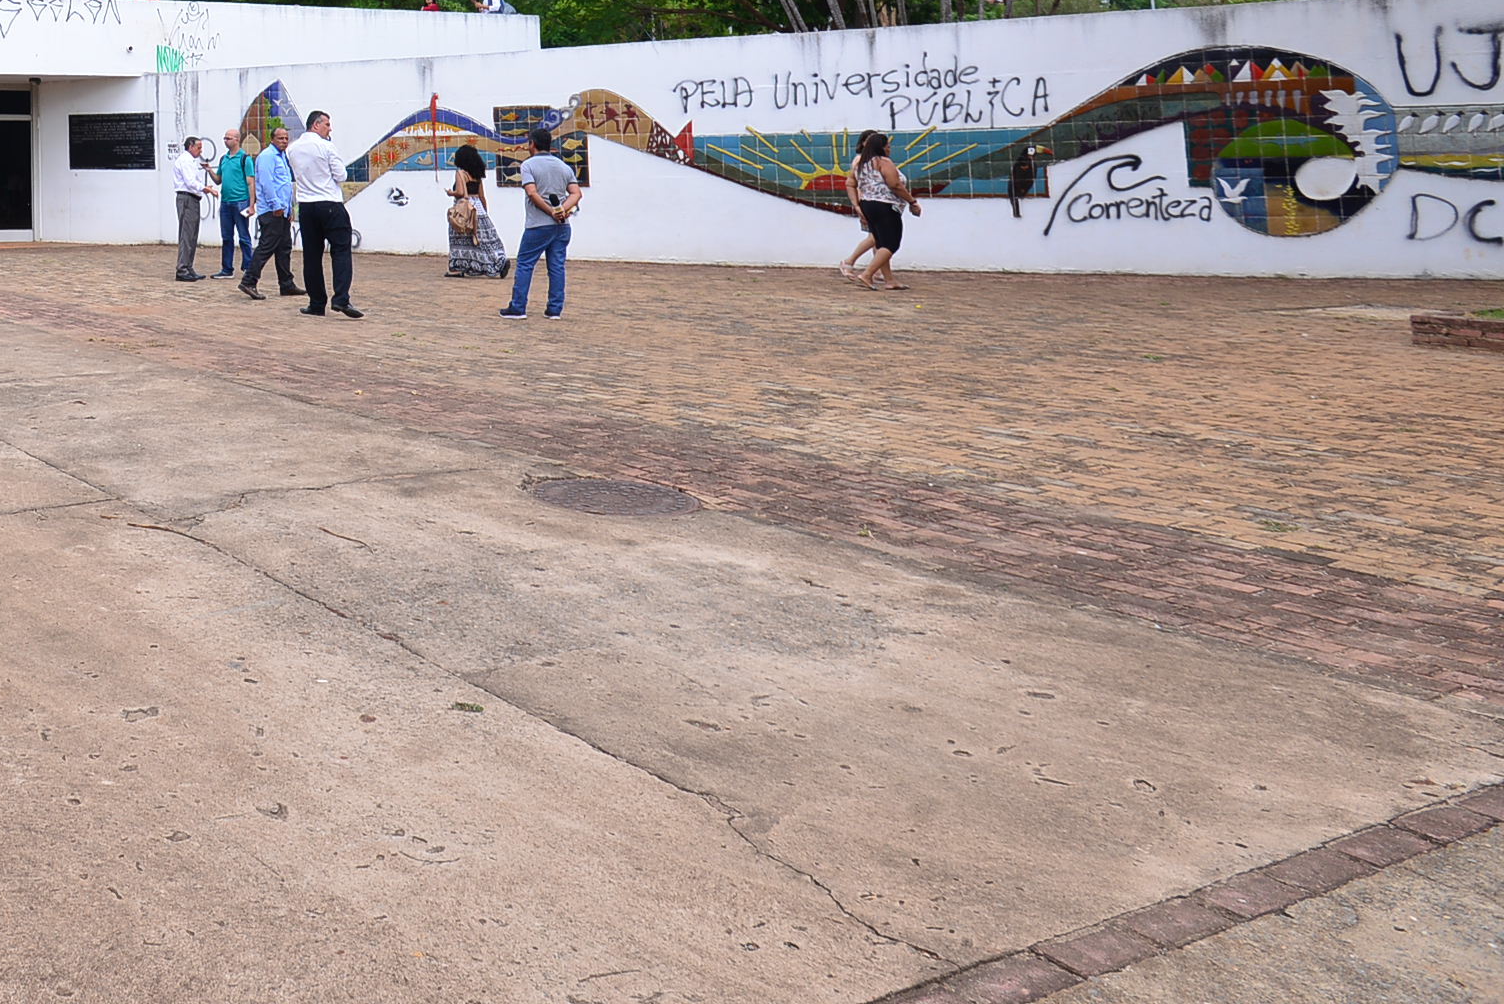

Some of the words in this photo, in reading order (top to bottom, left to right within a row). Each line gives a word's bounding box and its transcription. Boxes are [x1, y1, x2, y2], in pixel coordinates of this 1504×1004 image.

[674, 75, 754, 113] PELA
[772, 51, 980, 111] Universidade
[1066, 187, 1214, 224] Correnteza
